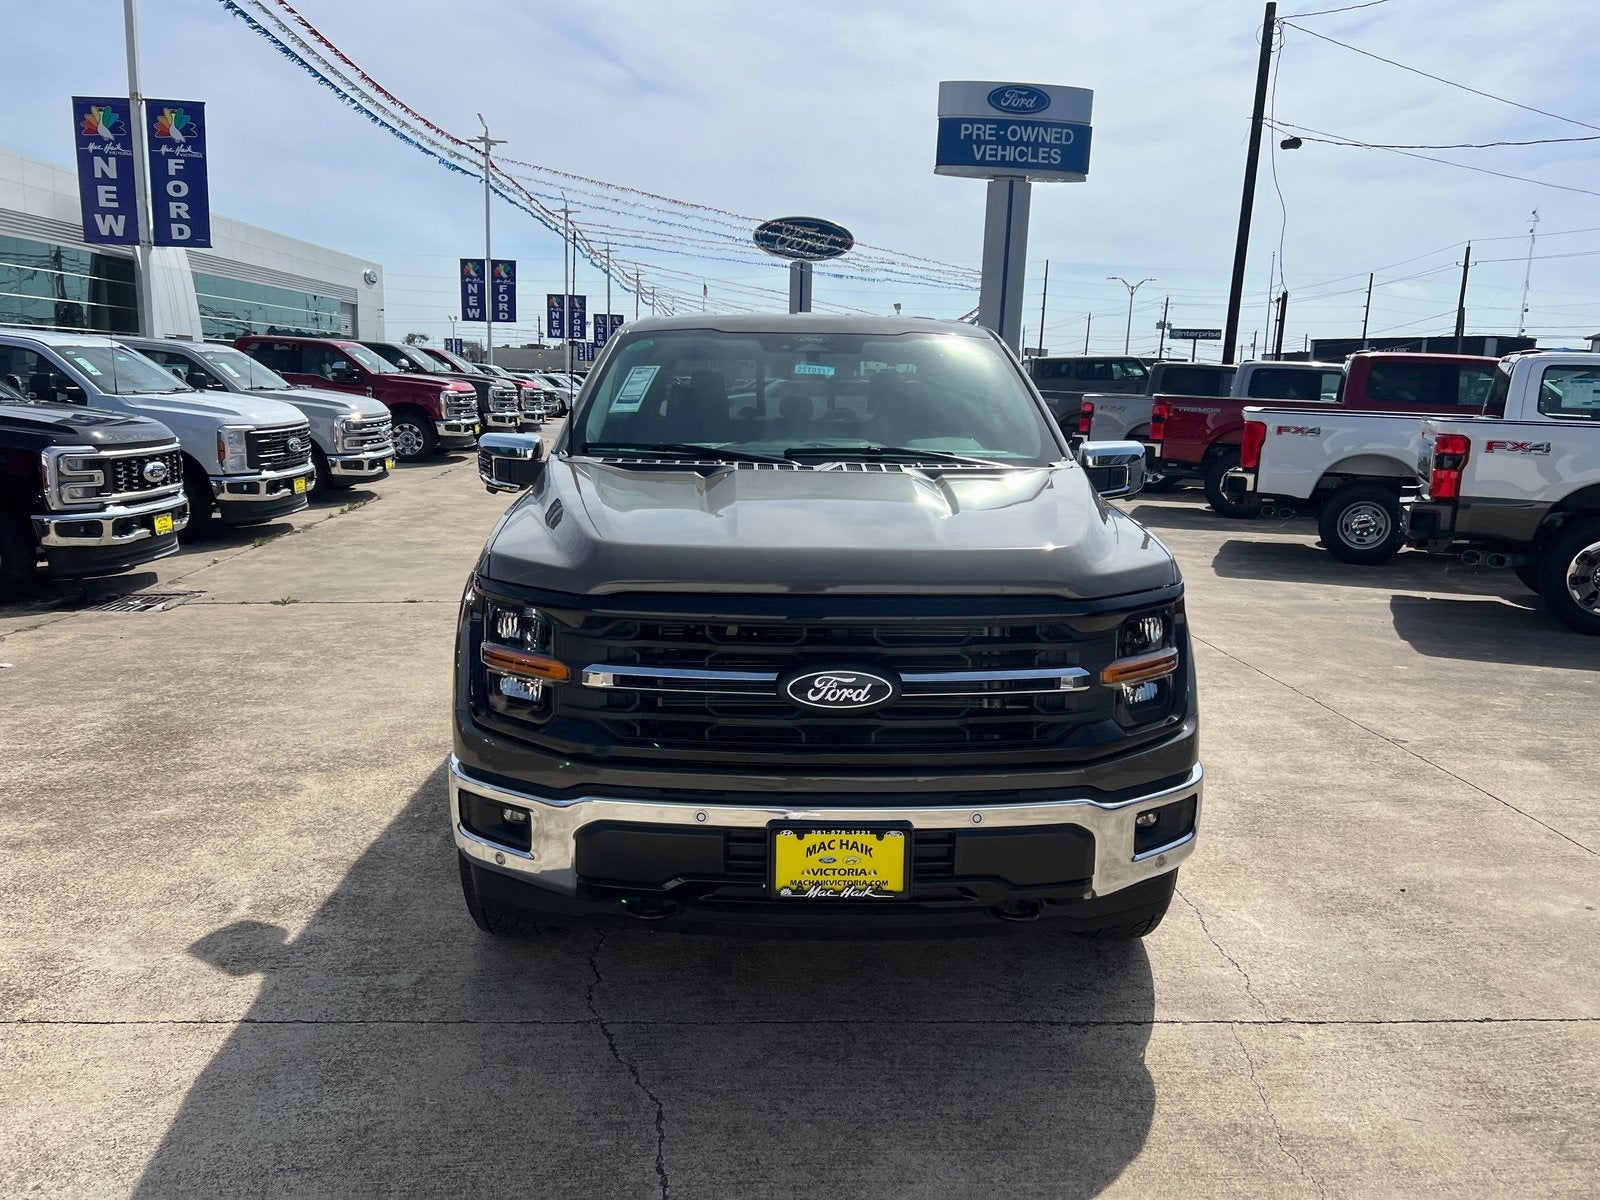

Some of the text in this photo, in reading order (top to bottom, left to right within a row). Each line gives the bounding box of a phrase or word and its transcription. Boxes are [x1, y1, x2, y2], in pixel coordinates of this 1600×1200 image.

[1000, 89, 1038, 108] Ford
[972, 144, 1062, 165] VEHICLES
[93, 156, 126, 237] NEW
[166, 158, 192, 240] FORD
[467, 283, 480, 319] NEW
[498, 284, 509, 320] FORD
[551, 311, 561, 337] NEW
[573, 312, 581, 338] FORD
[1171, 331, 1221, 339] enterprise
[1276, 426, 1321, 436] FX4
[1485, 440, 1551, 453] FX4
[807, 675, 873, 702] Ford
[806, 839, 874, 858] MAC HAIK
[811, 868, 867, 876] VICTORIA
[803, 885, 881, 899] Mac Haik
